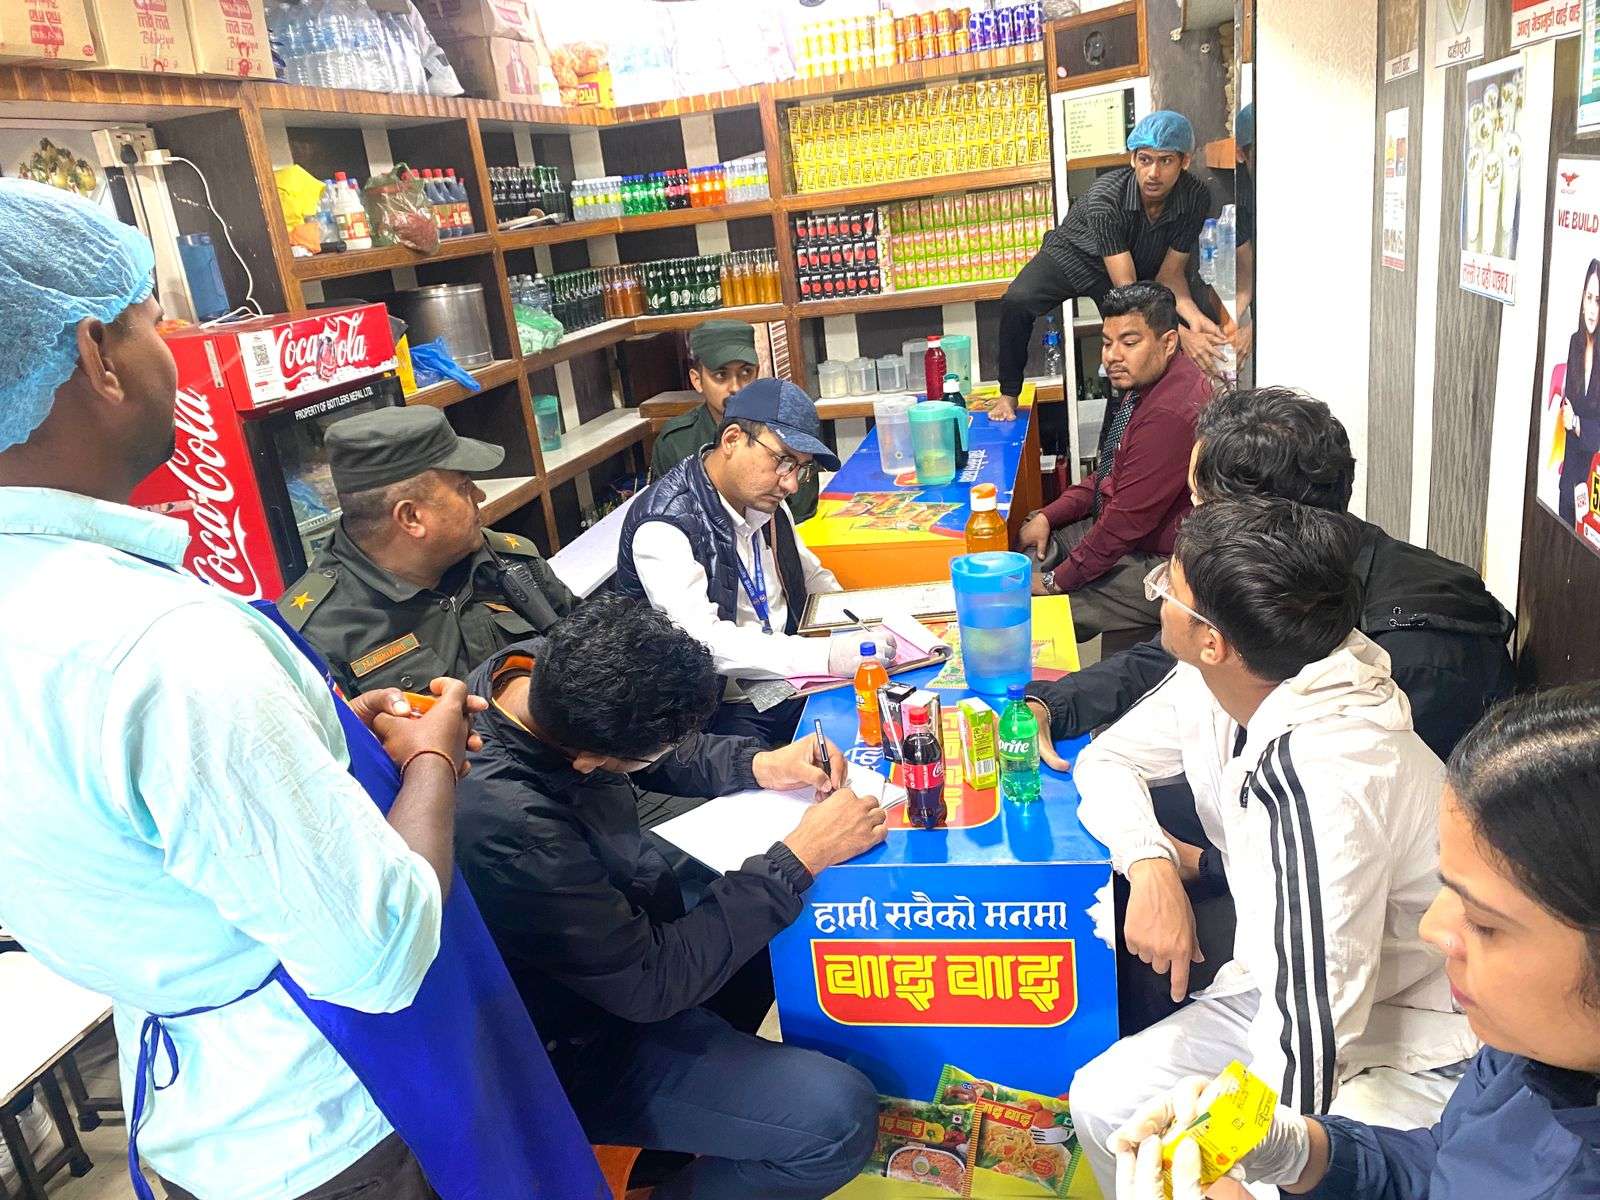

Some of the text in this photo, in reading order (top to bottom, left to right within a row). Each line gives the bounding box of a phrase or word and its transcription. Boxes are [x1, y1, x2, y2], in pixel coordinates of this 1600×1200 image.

[1558, 209, 1600, 234] WE BUILD
[294, 403, 321, 421] PROPERTY
[319, 401, 327, 412] OF
[326, 393, 351, 410] BOTTLERS
[350, 389, 364, 401] NEPAL
[999, 739, 1030, 754] prite
[811, 891, 1068, 934] हामी सबैको मनमा
